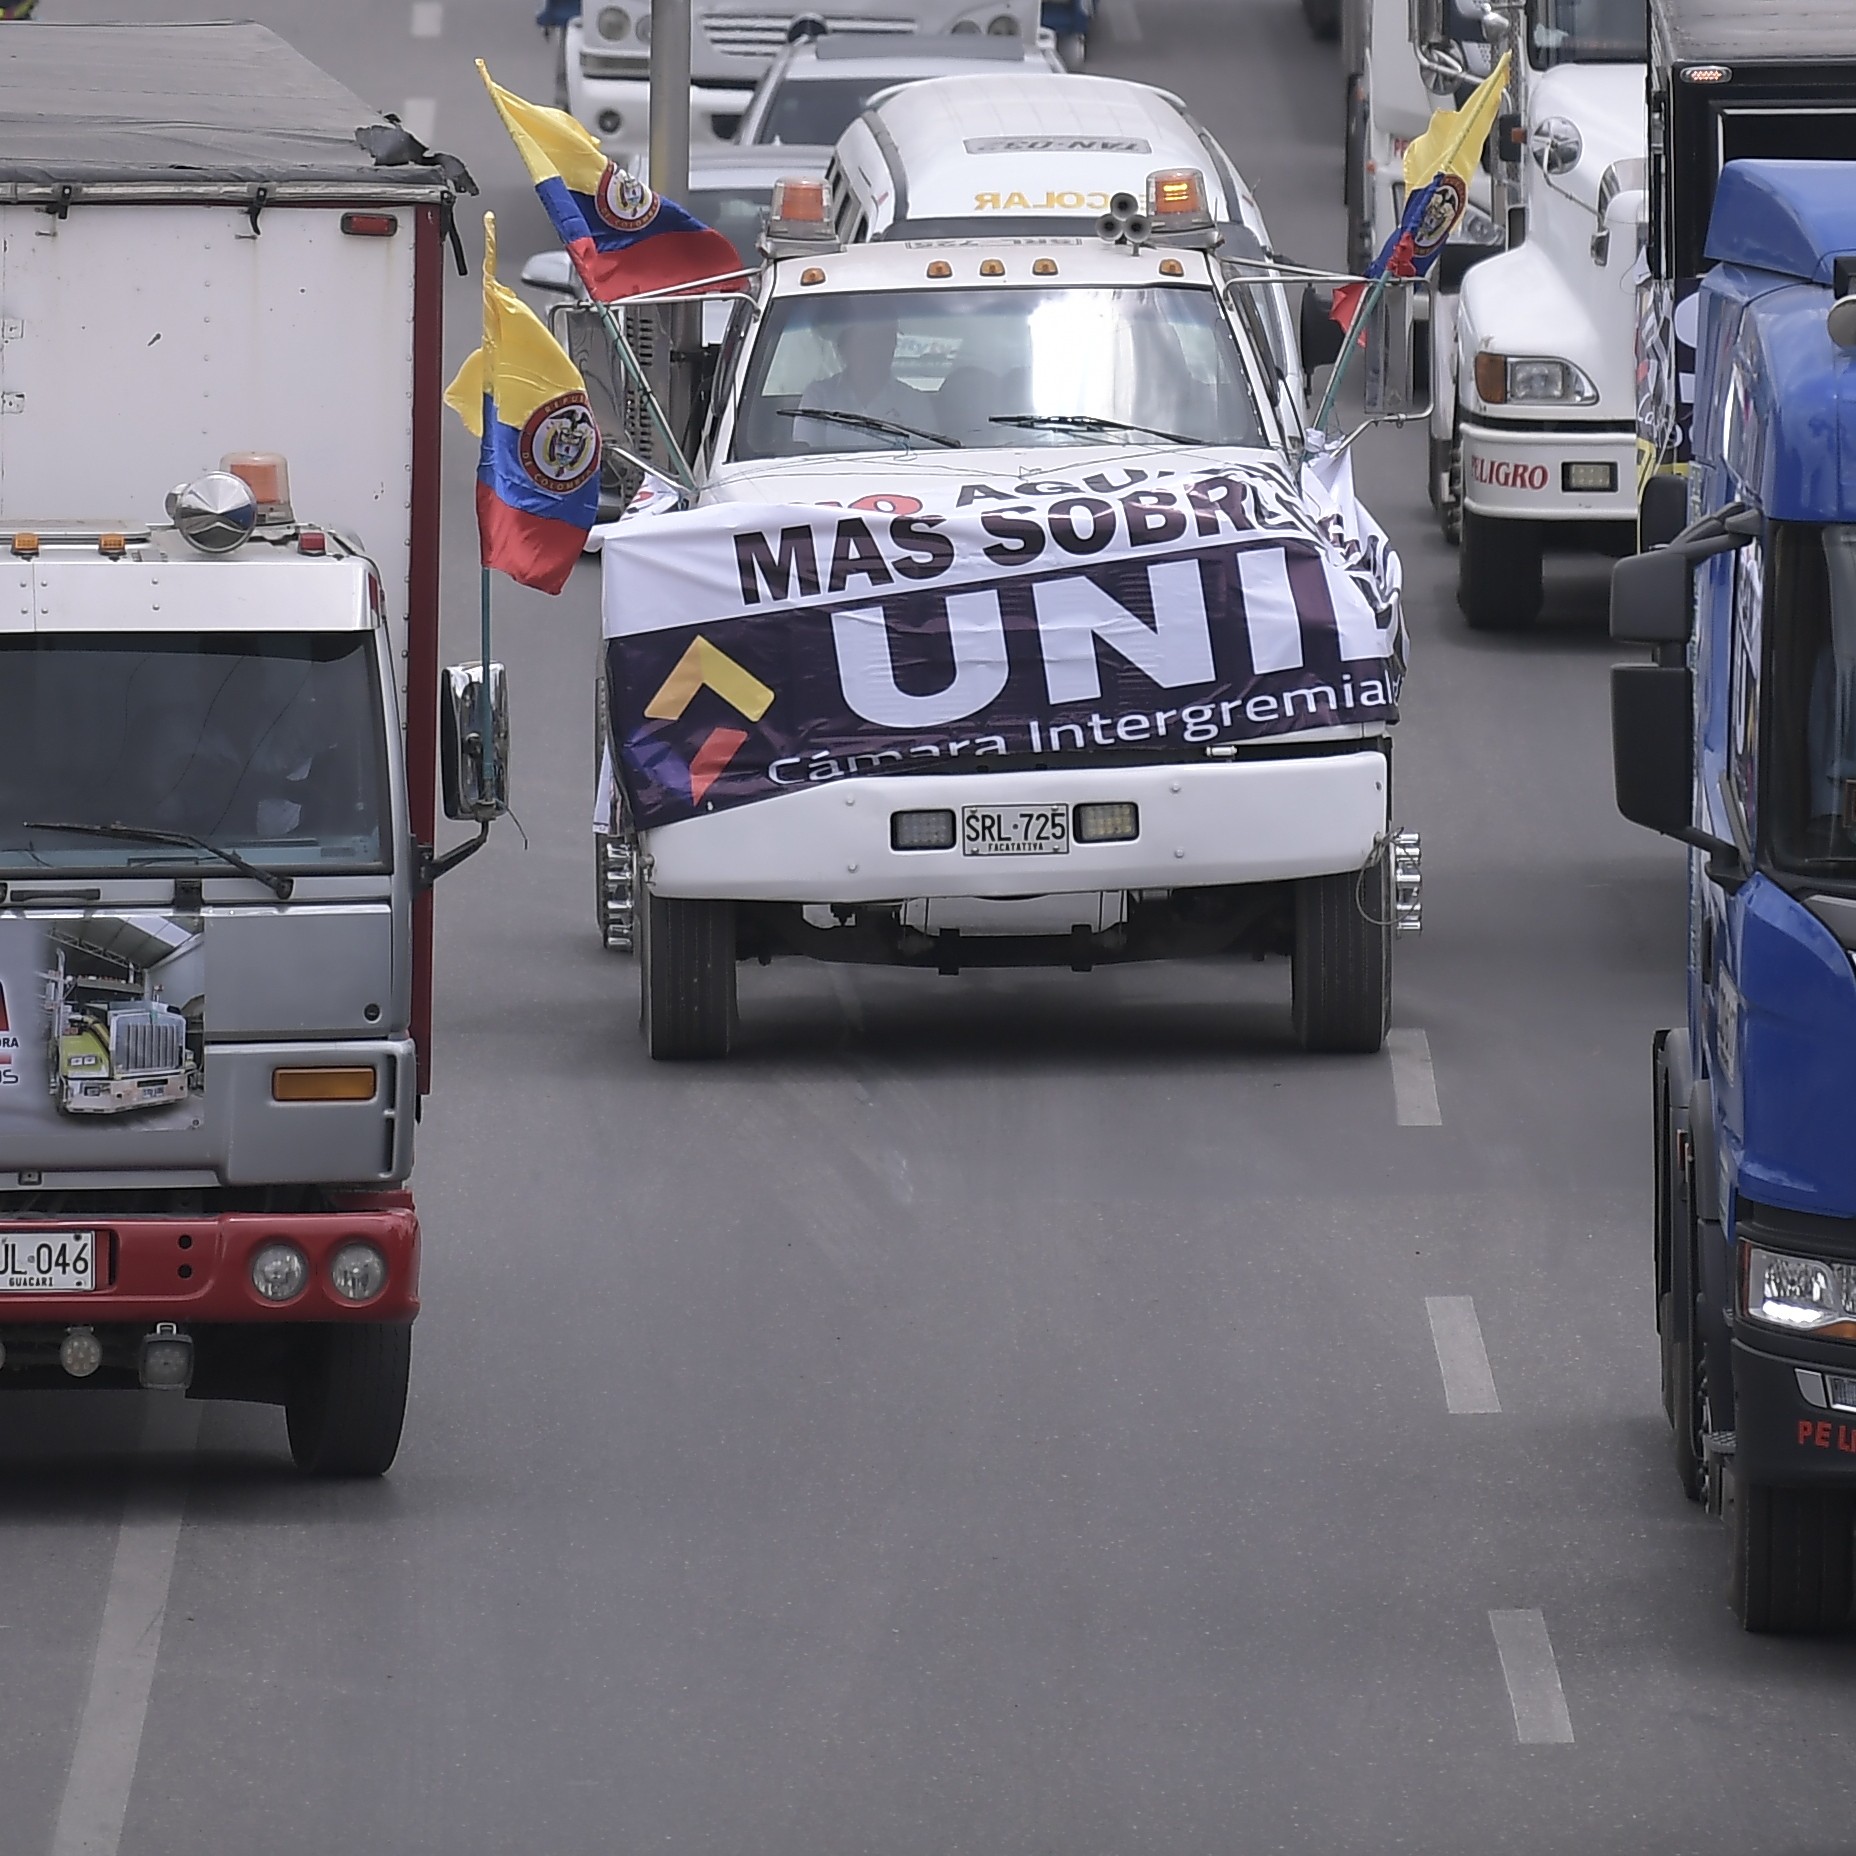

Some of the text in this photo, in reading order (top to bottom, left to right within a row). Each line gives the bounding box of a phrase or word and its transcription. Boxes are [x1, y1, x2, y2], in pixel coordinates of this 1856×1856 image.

[732, 513, 956, 607] MAS
[1029, 673, 1396, 752] Intergremial
[988, 842, 1044, 852] FACATATIVA
[8, 1277, 54, 1287] GUACARI
